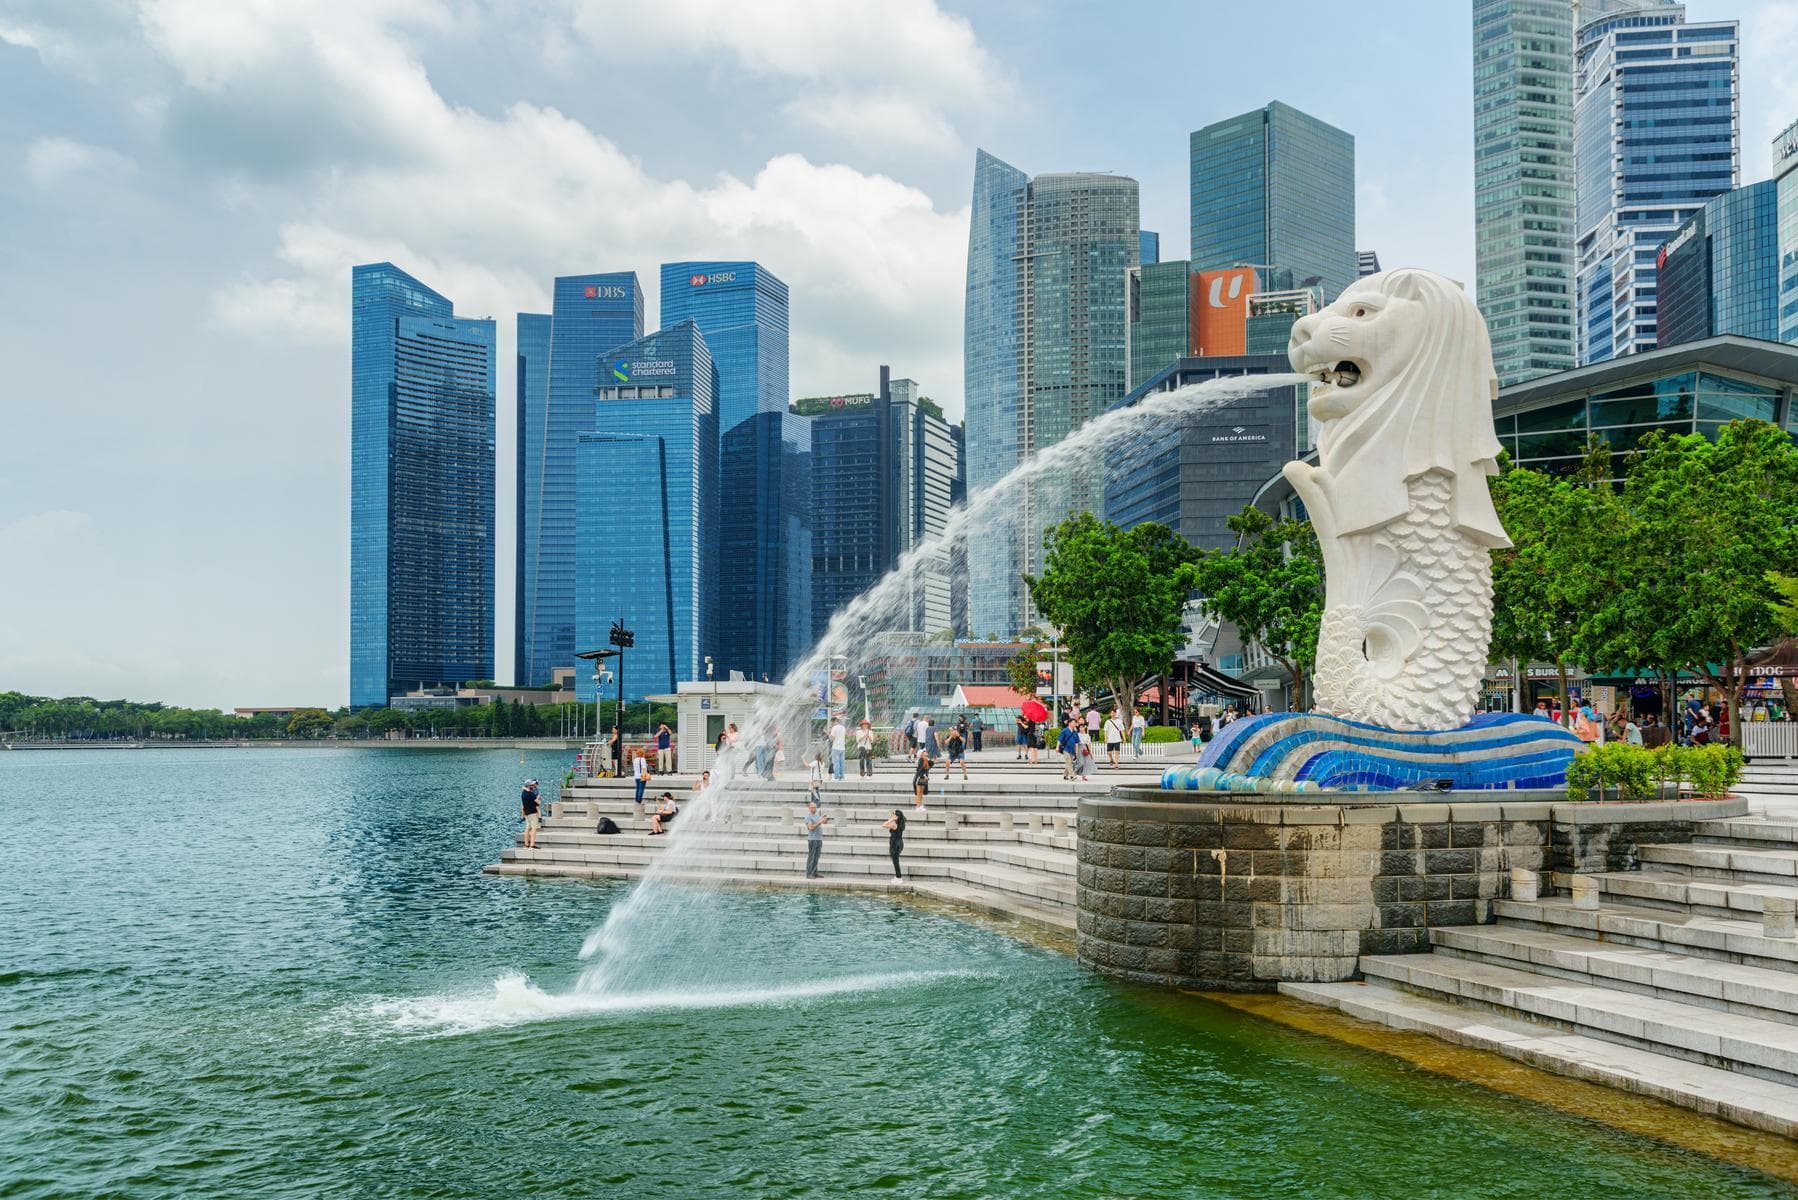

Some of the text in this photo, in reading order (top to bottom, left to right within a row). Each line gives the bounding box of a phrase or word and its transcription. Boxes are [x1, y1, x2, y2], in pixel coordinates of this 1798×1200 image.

[708, 272, 737, 283] HSBC
[598, 286, 626, 298] DBS
[632, 360, 674, 369] standard
[632, 368, 676, 376] chartered
[845, 396, 870, 405] MUFG
